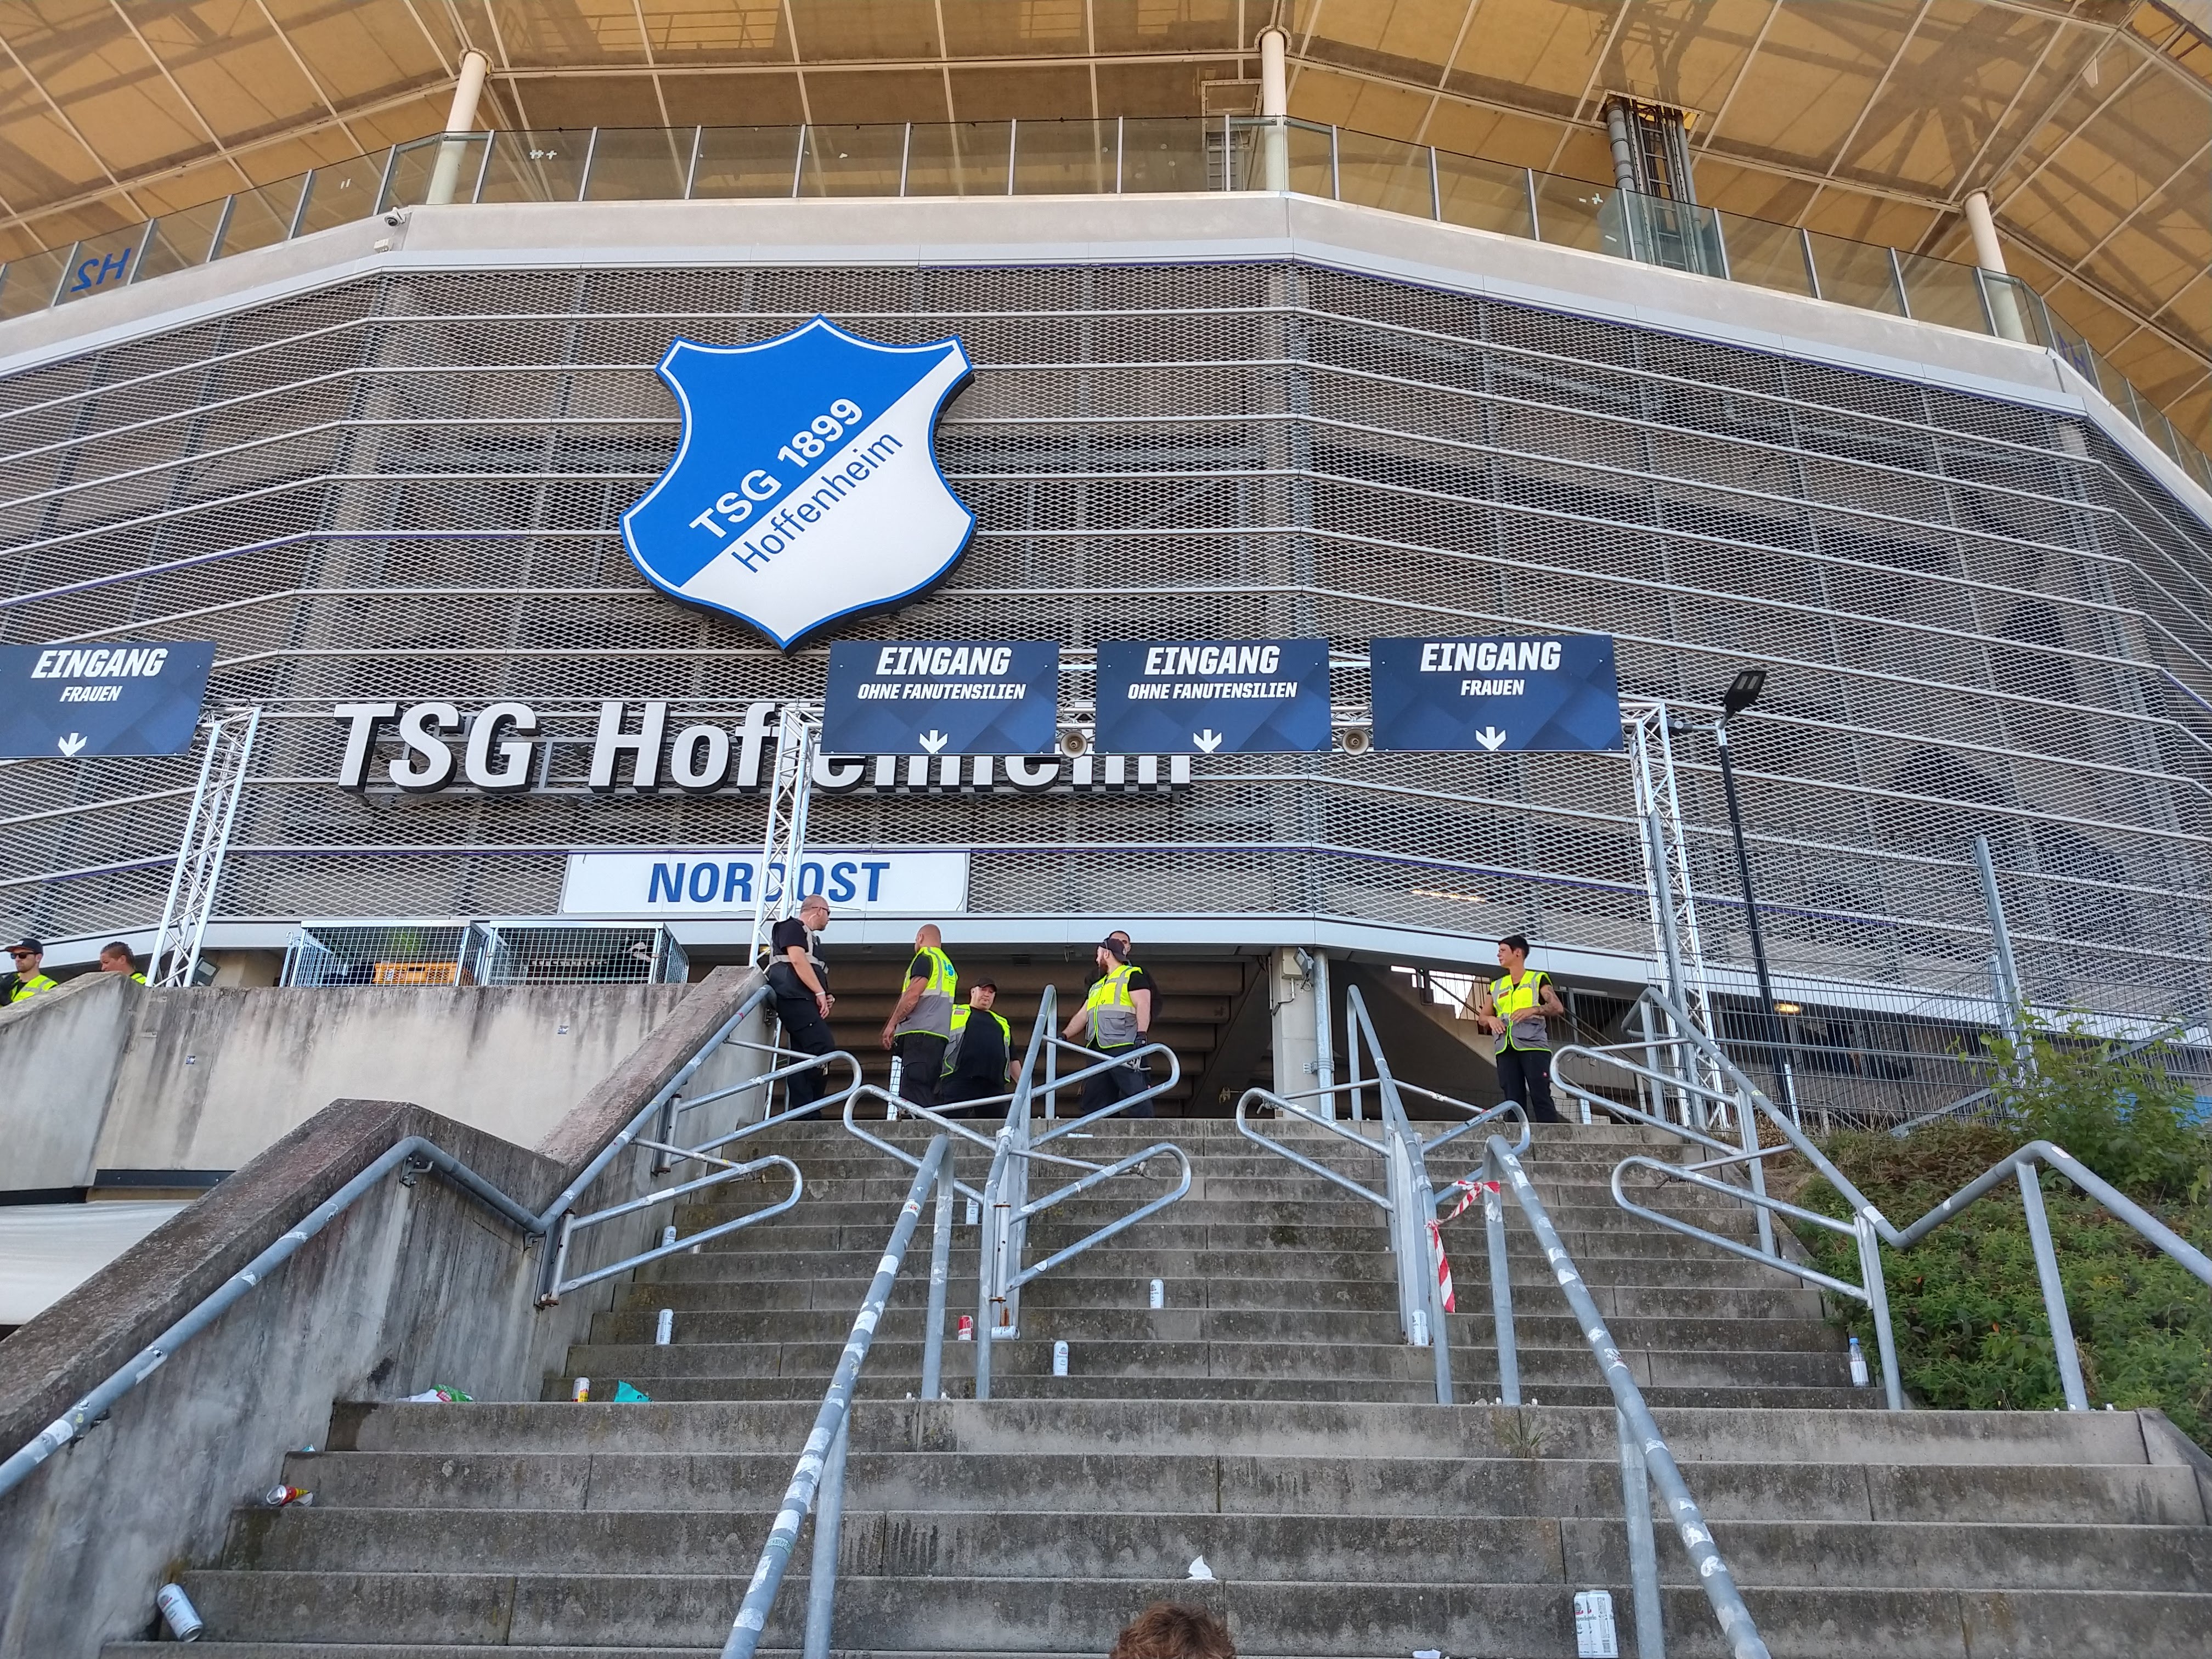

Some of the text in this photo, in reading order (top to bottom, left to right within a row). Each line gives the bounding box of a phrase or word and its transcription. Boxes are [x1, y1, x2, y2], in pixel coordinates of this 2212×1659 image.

[689, 398, 863, 539] TSG 1899
[730, 433, 904, 574] Hoffenheim
[31, 648, 169, 679] EINGANG
[876, 646, 1013, 676] EINGANG
[1144, 645, 1281, 675] EINGANG
[1420, 641, 1563, 672] EINGANG
[59, 685, 123, 702] FRAUEN
[857, 683, 1027, 700] OHNE FANUTENSILIEN
[1127, 682, 1298, 699] OHNE FANUTENSILIEN
[1460, 679, 1526, 696] FRAUEN
[332, 702, 539, 789] TSG
